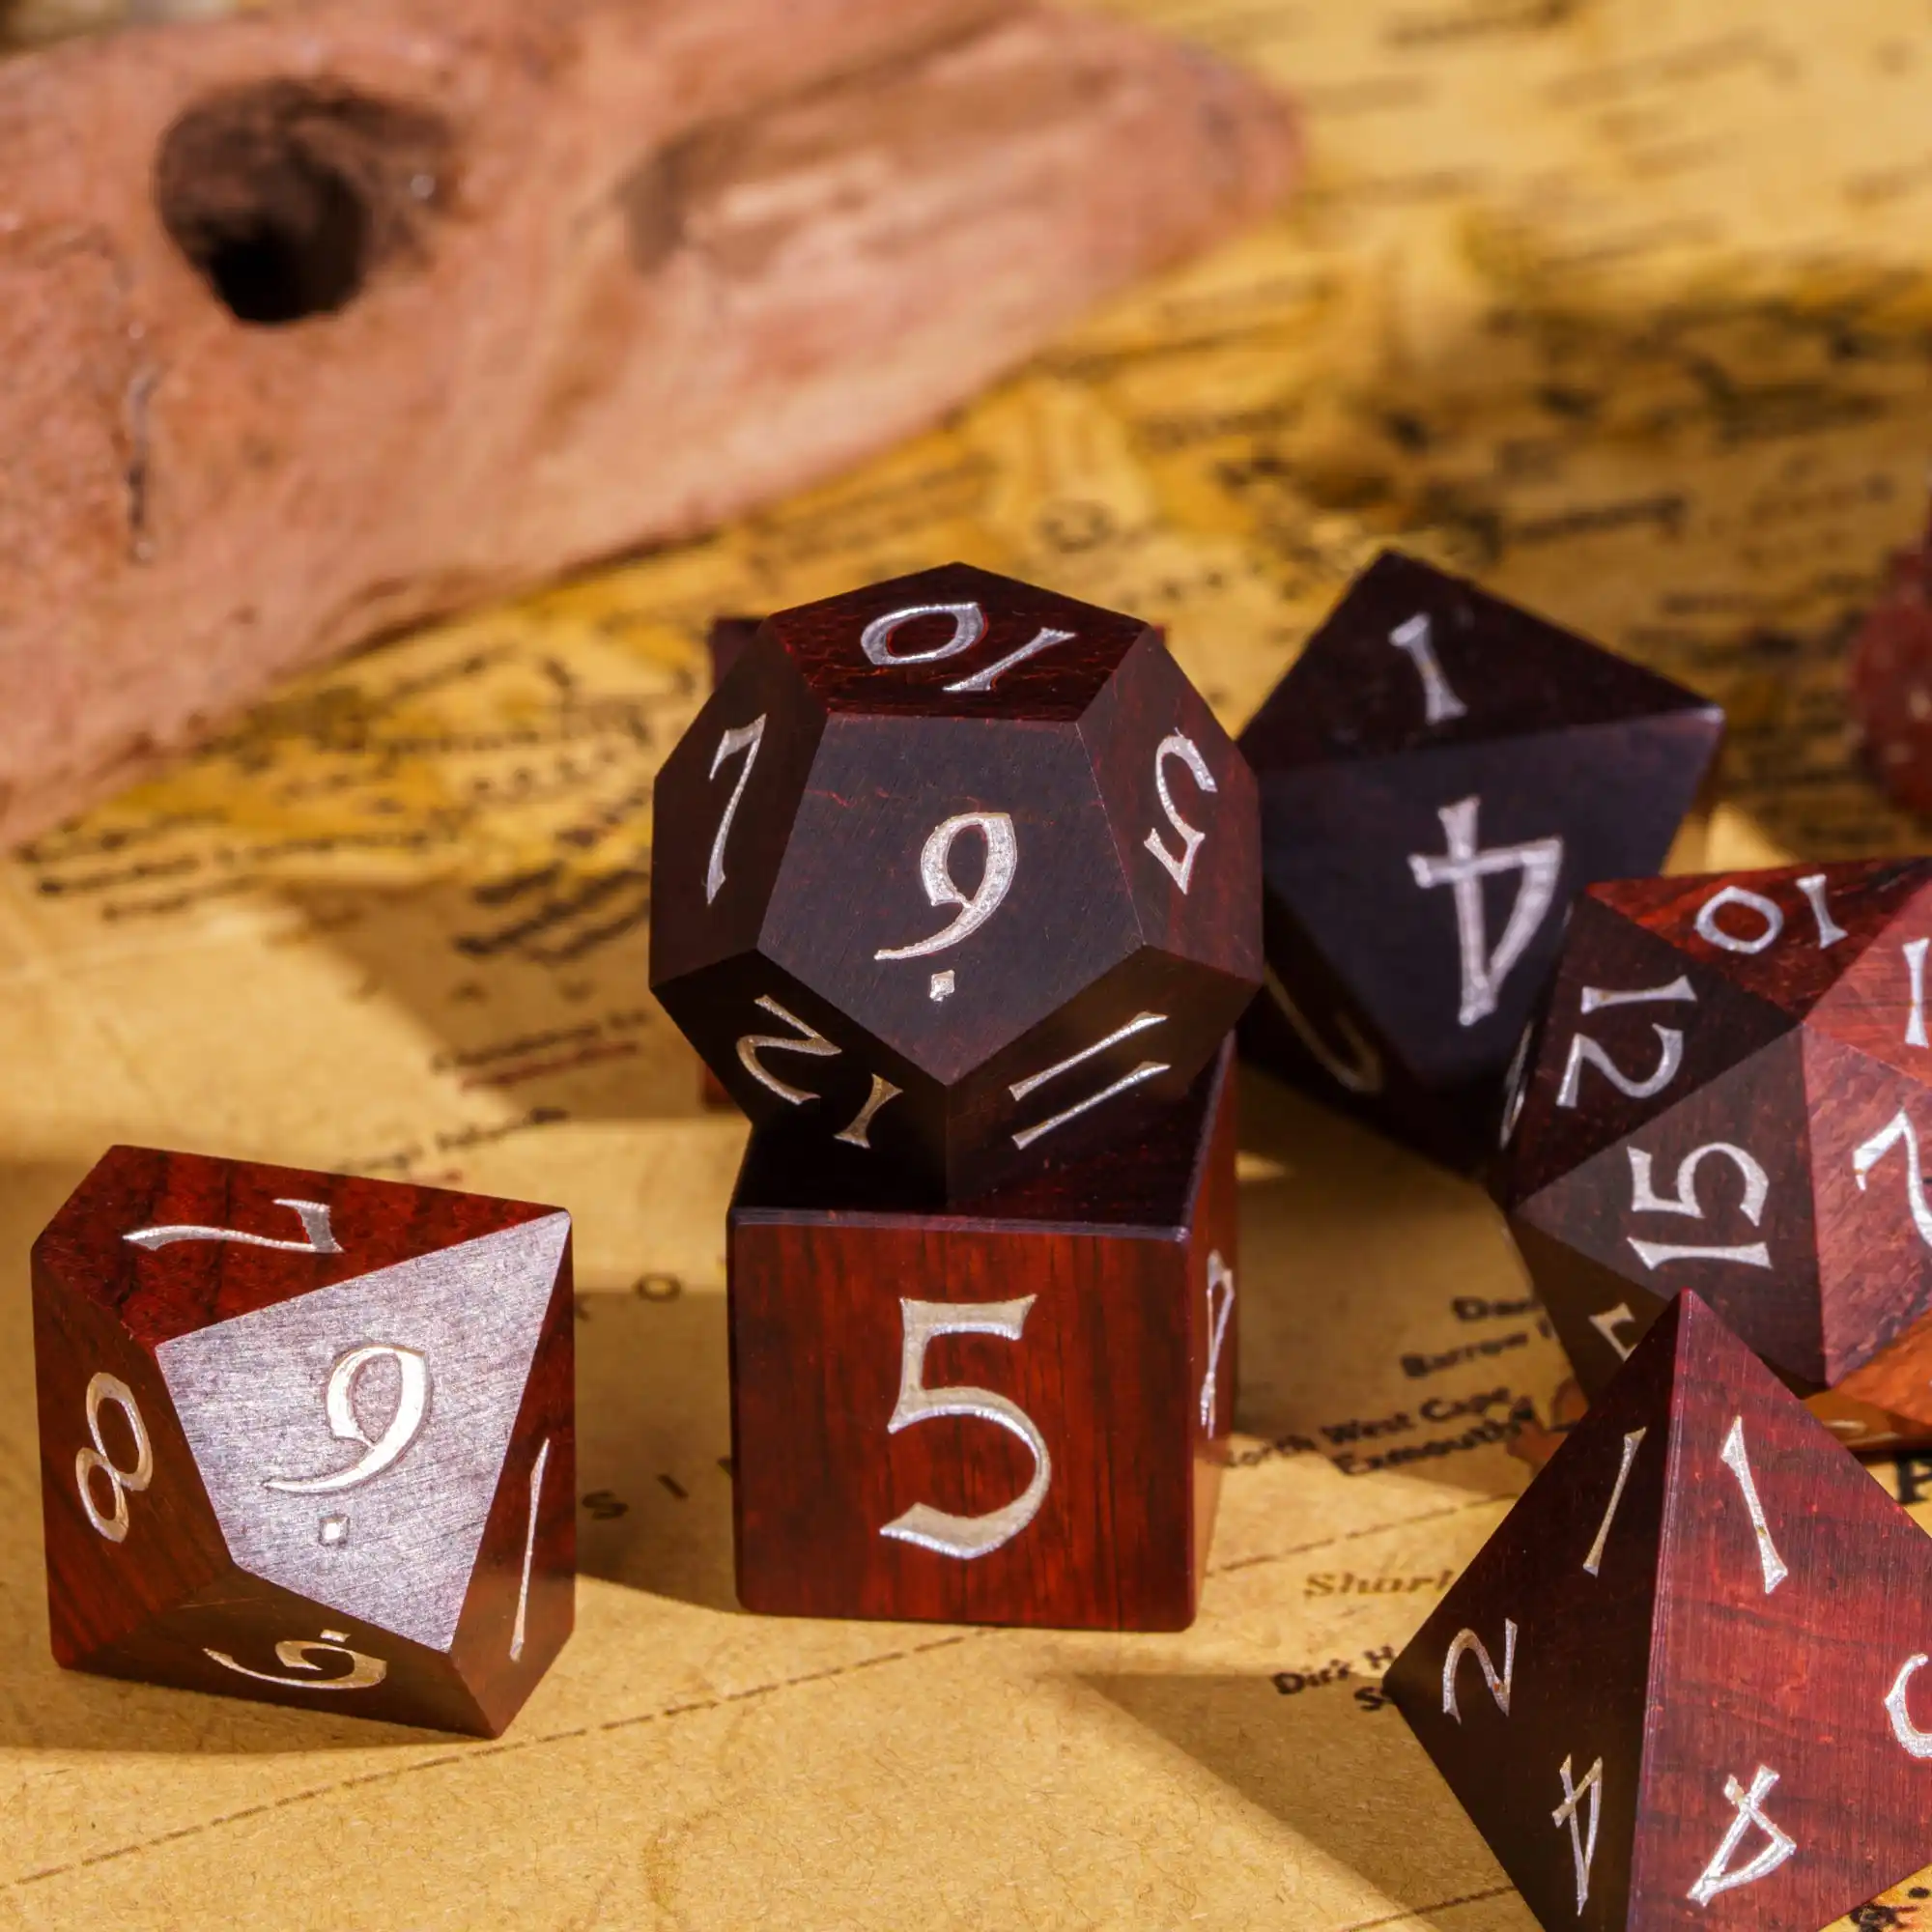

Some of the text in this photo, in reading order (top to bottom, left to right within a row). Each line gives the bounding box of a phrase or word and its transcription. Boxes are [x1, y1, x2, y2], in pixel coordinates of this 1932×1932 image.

[1389, 611, 1467, 725] 1
[706, 713, 767, 906] 7
[1407, 796, 1564, 1026] 4
[1694, 872, 1847, 954] 10
[1009, 1010, 1172, 1151] 11
[122, 1197, 345, 1255] 7
[1626, 1141, 1774, 1271] 15
[75, 1372, 153, 1543] 8
[880, 1293, 1051, 1560] 5
[1583, 1427, 1646, 1577] 1
[1719, 1415, 1788, 1594] 1
[509, 1437, 549, 1662] 1
[1552, 1752, 1603, 1916] 4
[1687, 1765, 1796, 1907] 4
